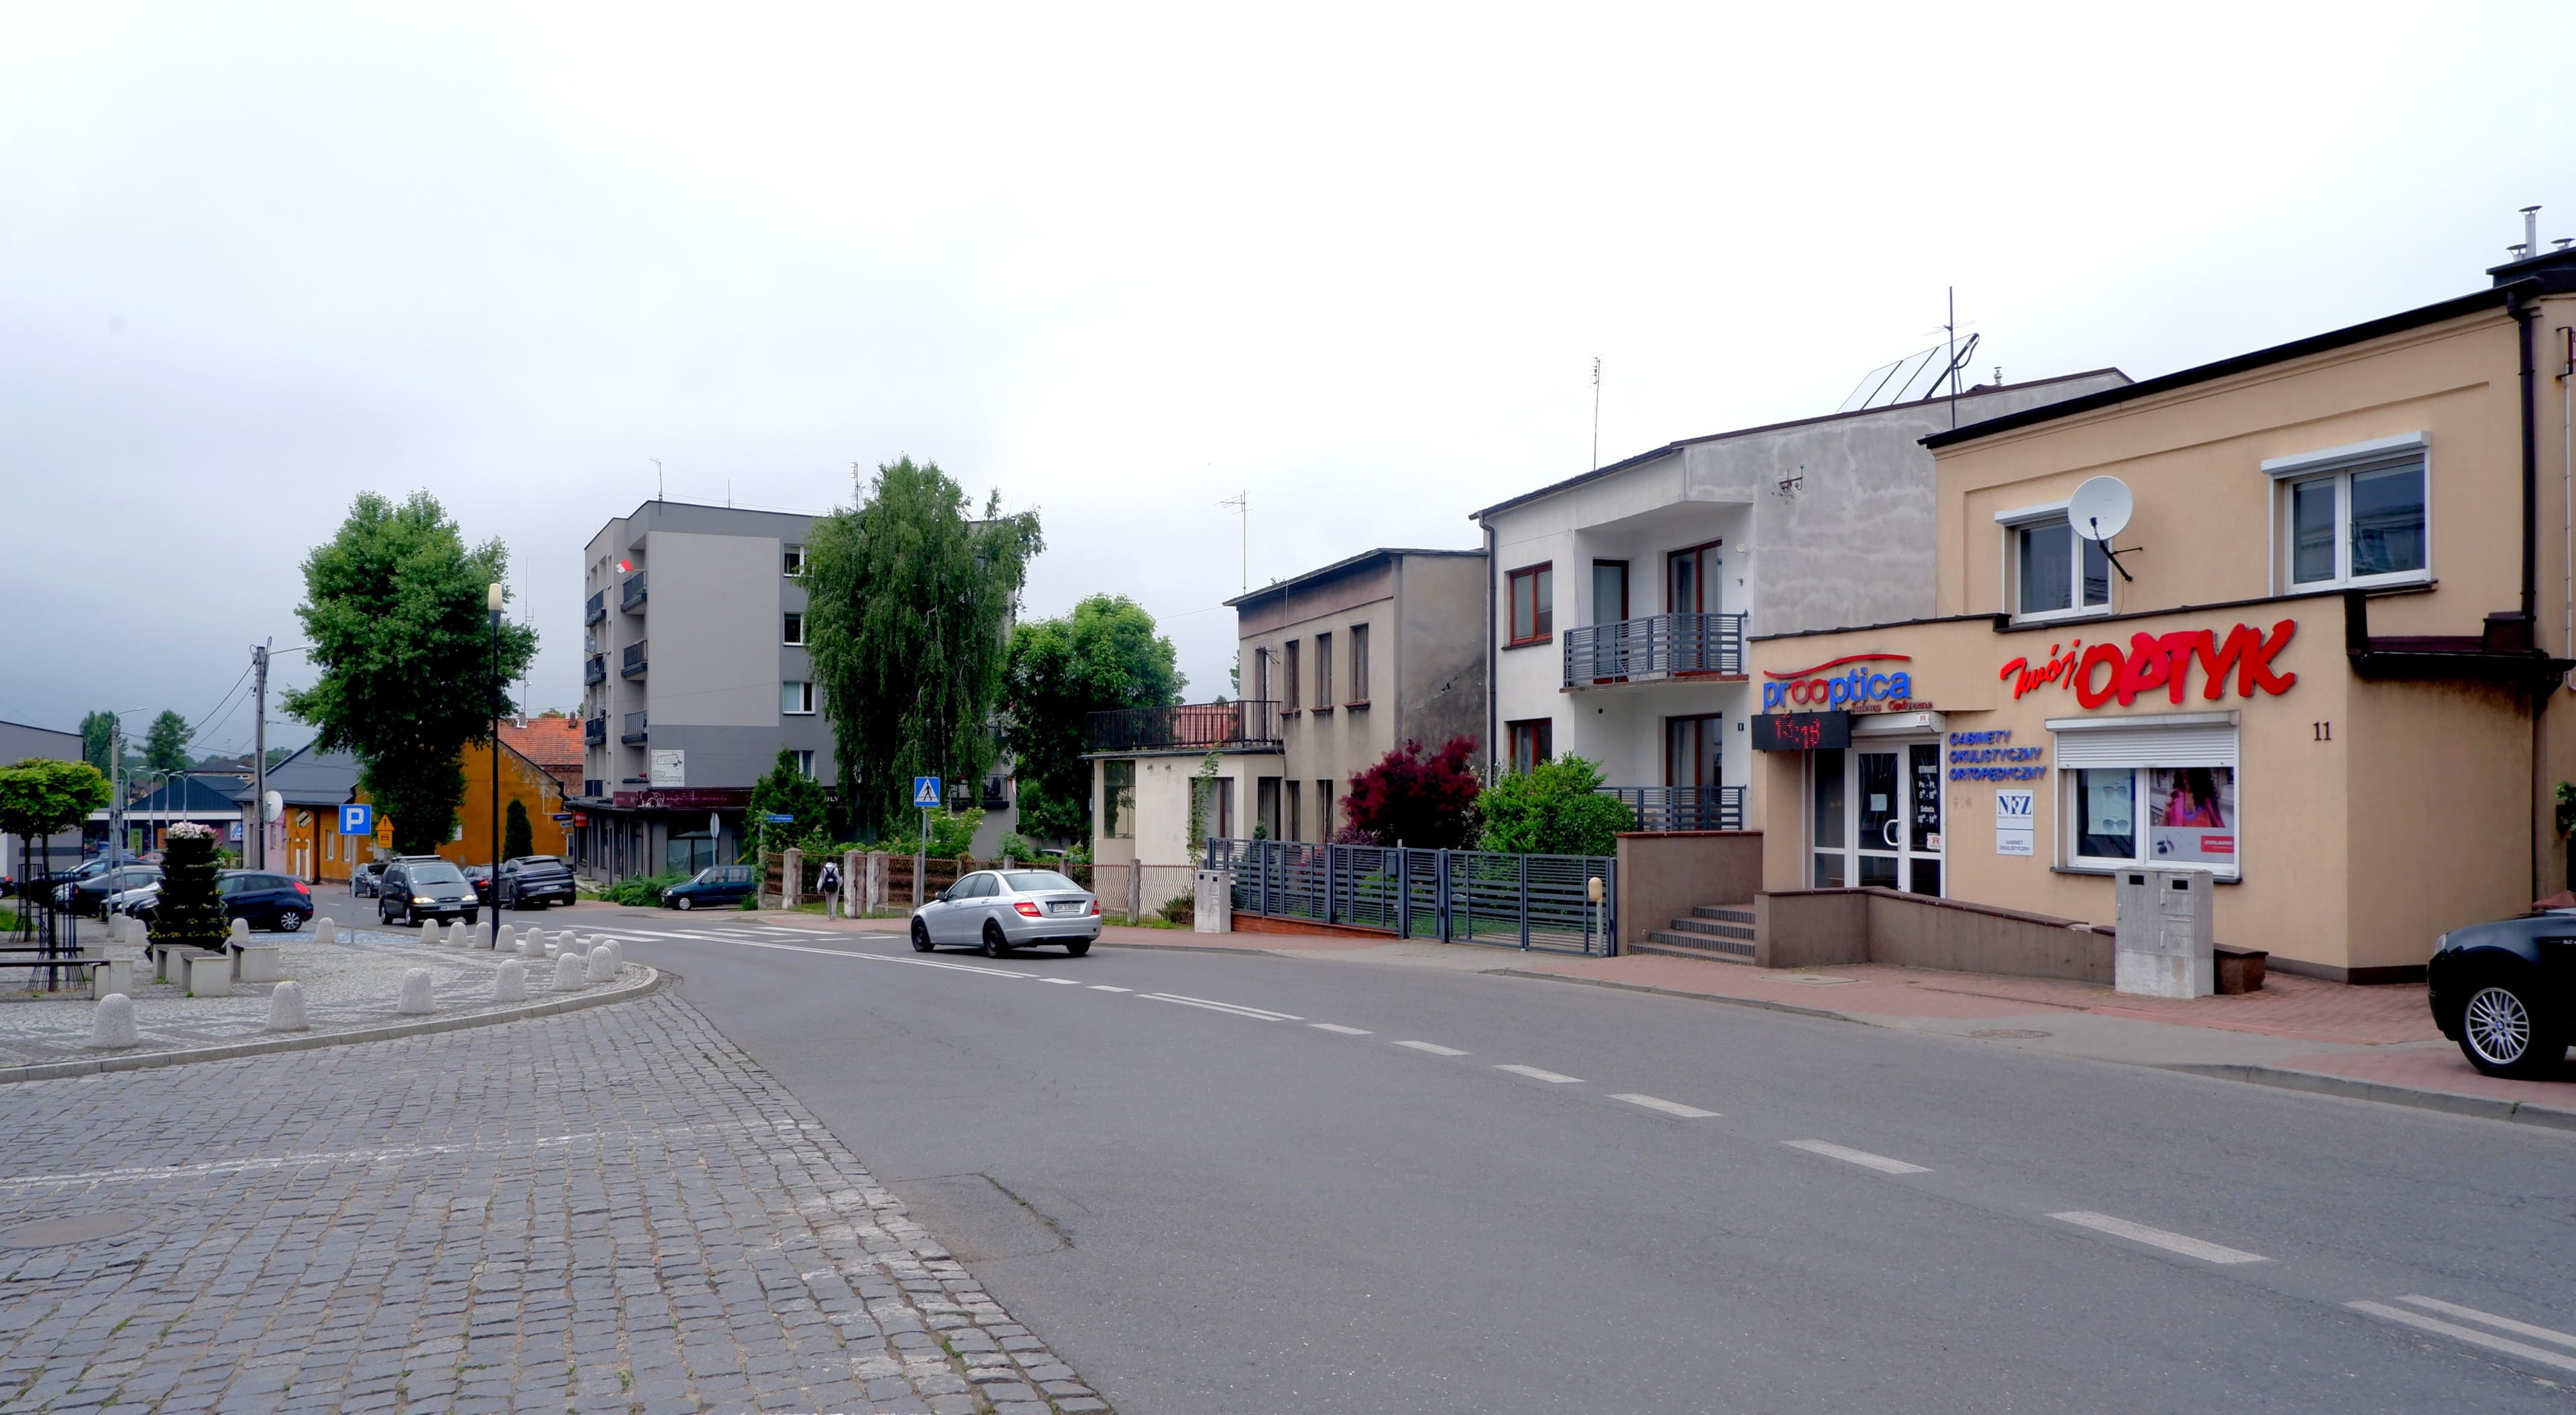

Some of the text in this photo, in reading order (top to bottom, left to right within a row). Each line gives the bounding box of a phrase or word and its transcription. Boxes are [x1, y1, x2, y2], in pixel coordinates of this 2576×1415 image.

[2000, 618, 2298, 710] Twój OPTYK
[1762, 667, 1912, 714] prooptica
[1949, 729, 2012, 746] GABINETY
[2312, 721, 2332, 741] 11
[1948, 747, 2043, 763] OKULISTYCZNY
[1948, 765, 2047, 781] ORTOPEDYCZNY
[1998, 795, 2032, 815] NFZ
[346, 807, 364, 832] P
